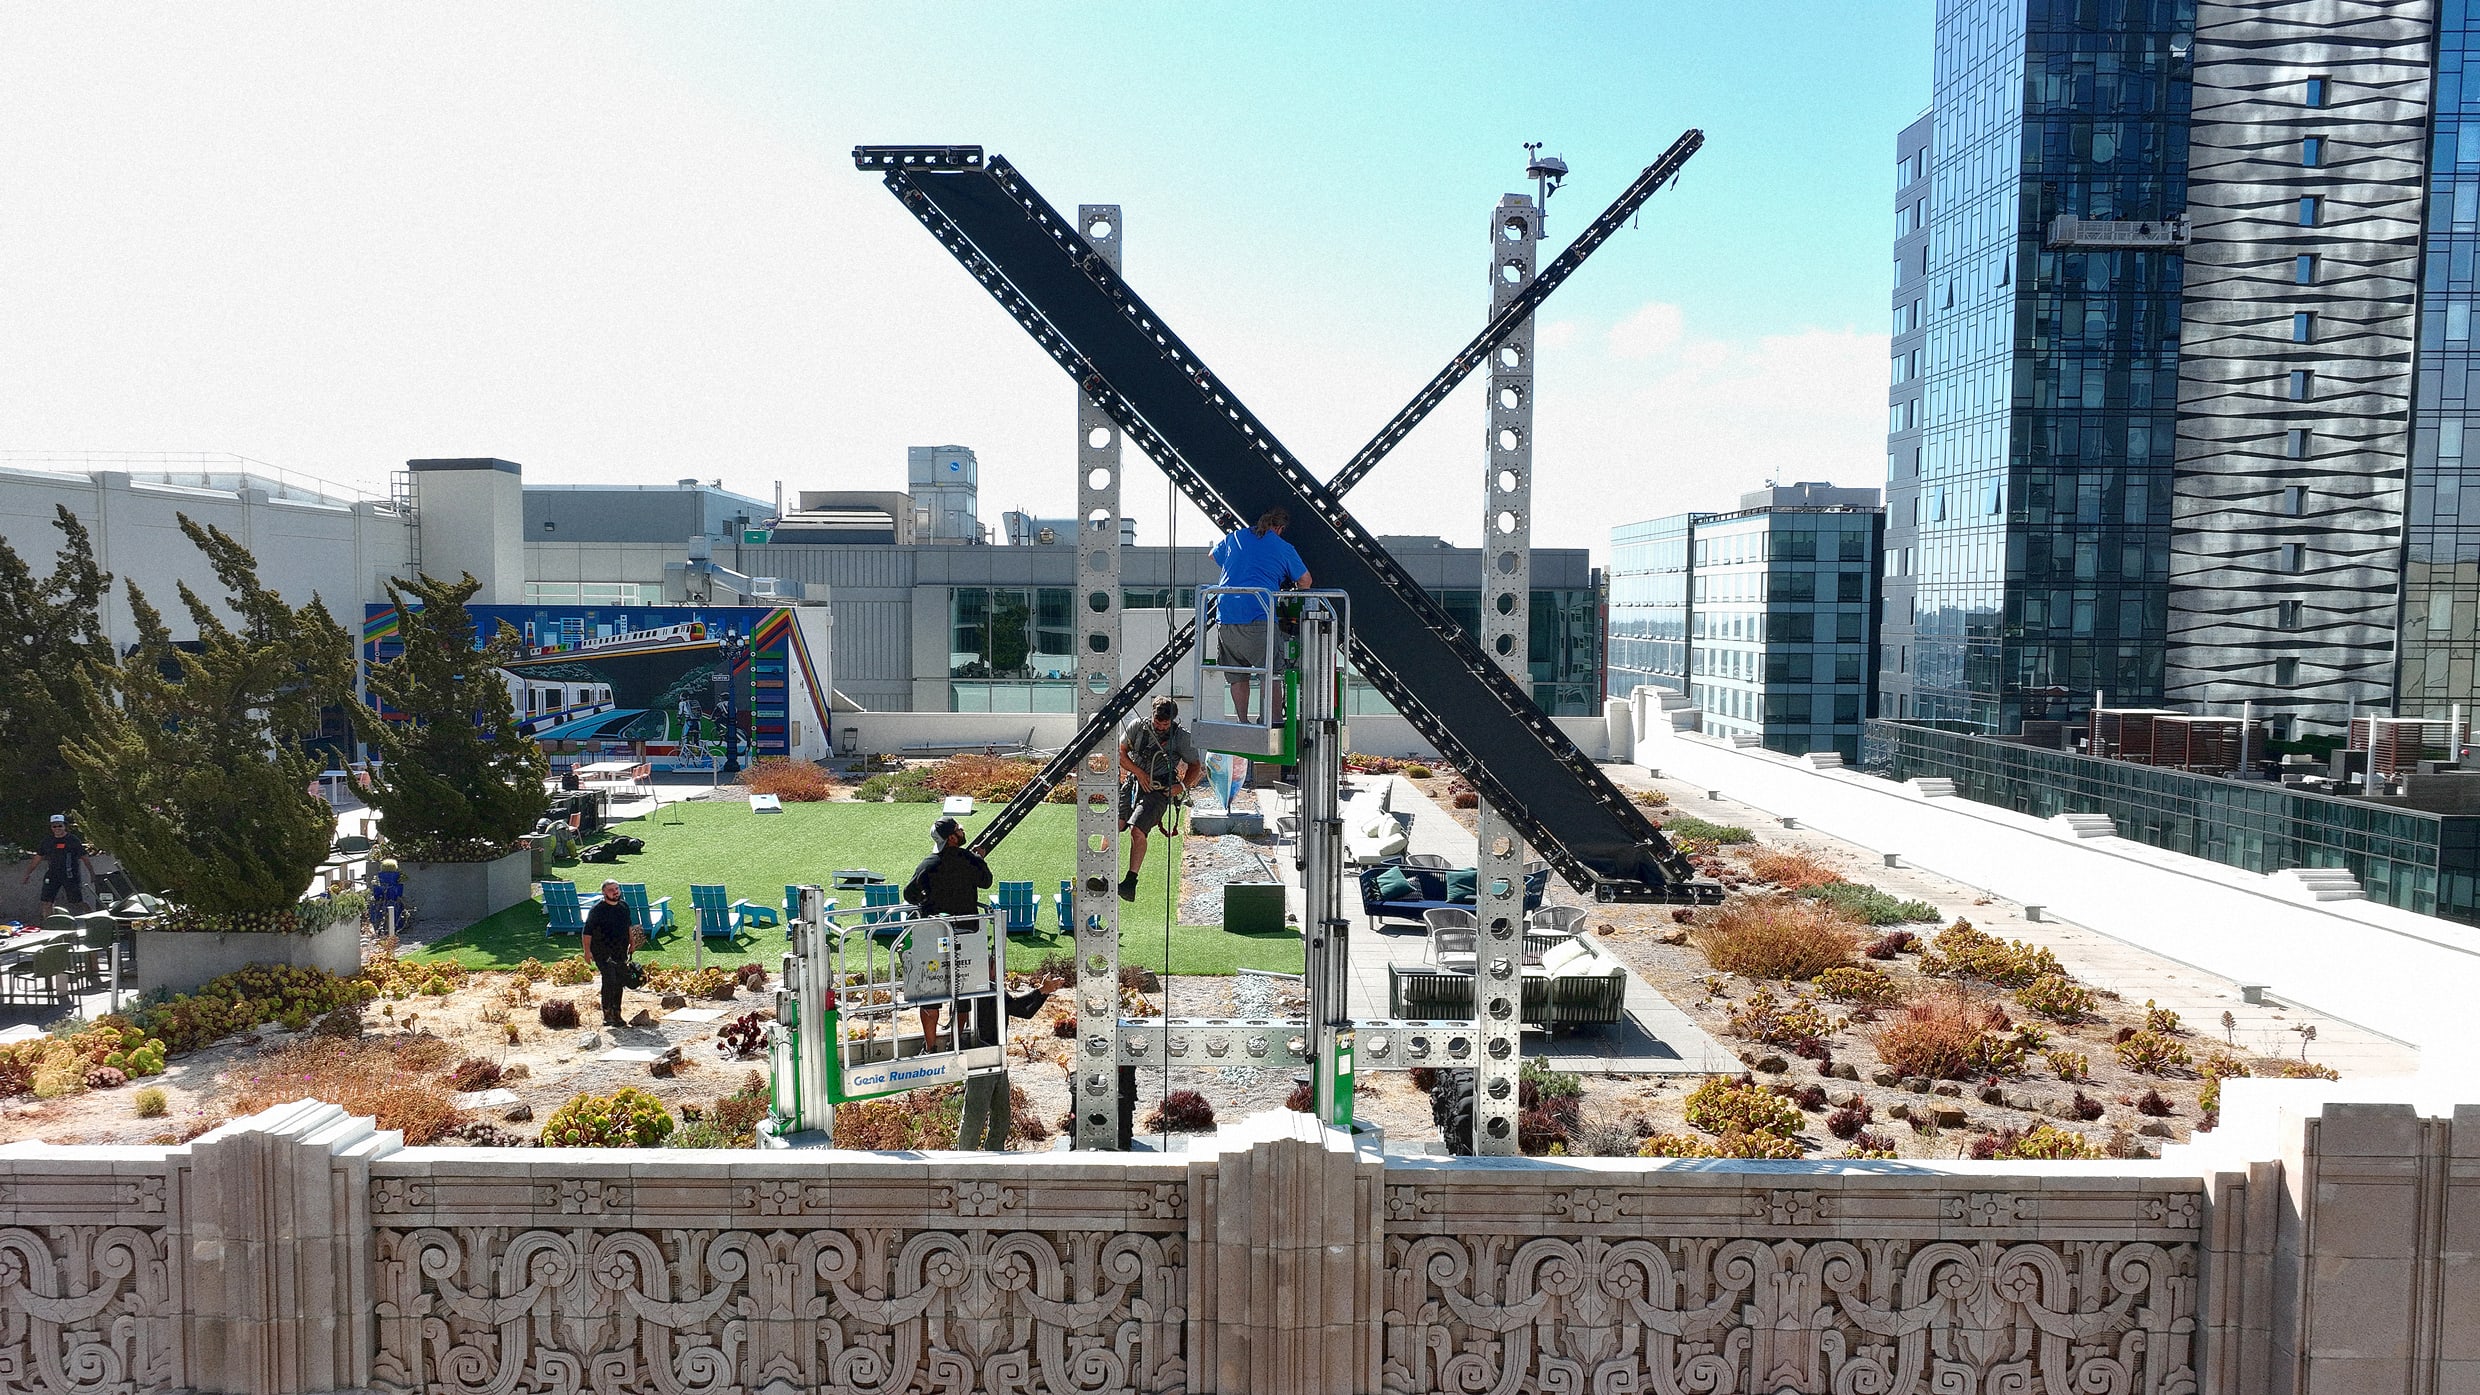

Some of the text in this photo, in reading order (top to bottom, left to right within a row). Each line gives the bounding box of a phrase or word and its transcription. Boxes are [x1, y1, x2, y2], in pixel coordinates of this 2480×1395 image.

[941, 959, 972, 968] SUELT
[854, 1065, 946, 1086] Genie Runabout
